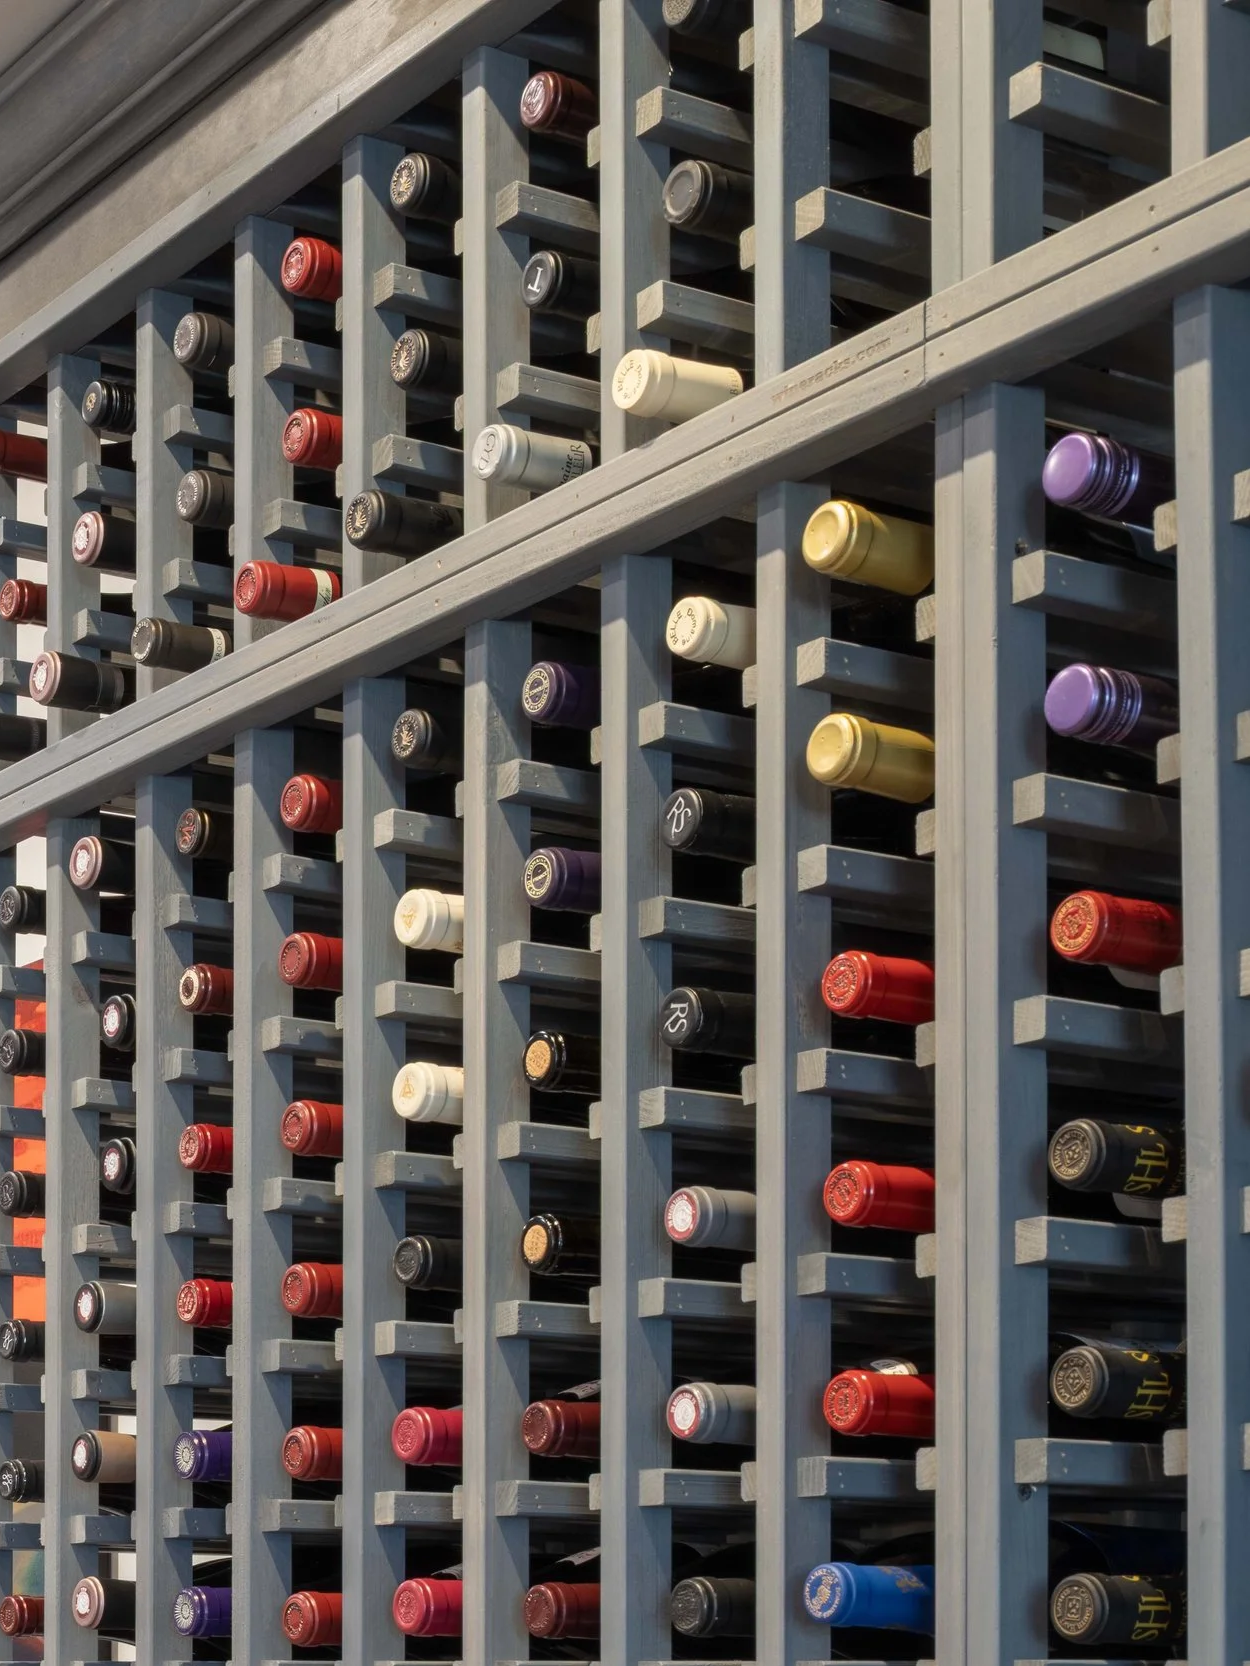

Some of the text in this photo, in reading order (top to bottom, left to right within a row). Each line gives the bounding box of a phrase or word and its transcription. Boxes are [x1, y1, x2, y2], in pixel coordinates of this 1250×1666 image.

[771, 337, 892, 405] wineracks.com
[668, 609, 684, 646] BELLE
[663, 1001, 689, 1033] RS
[1124, 1143, 1169, 1194] SHL
[1123, 1373, 1173, 1419] SHL
[1131, 1590, 1172, 1641] SHL
